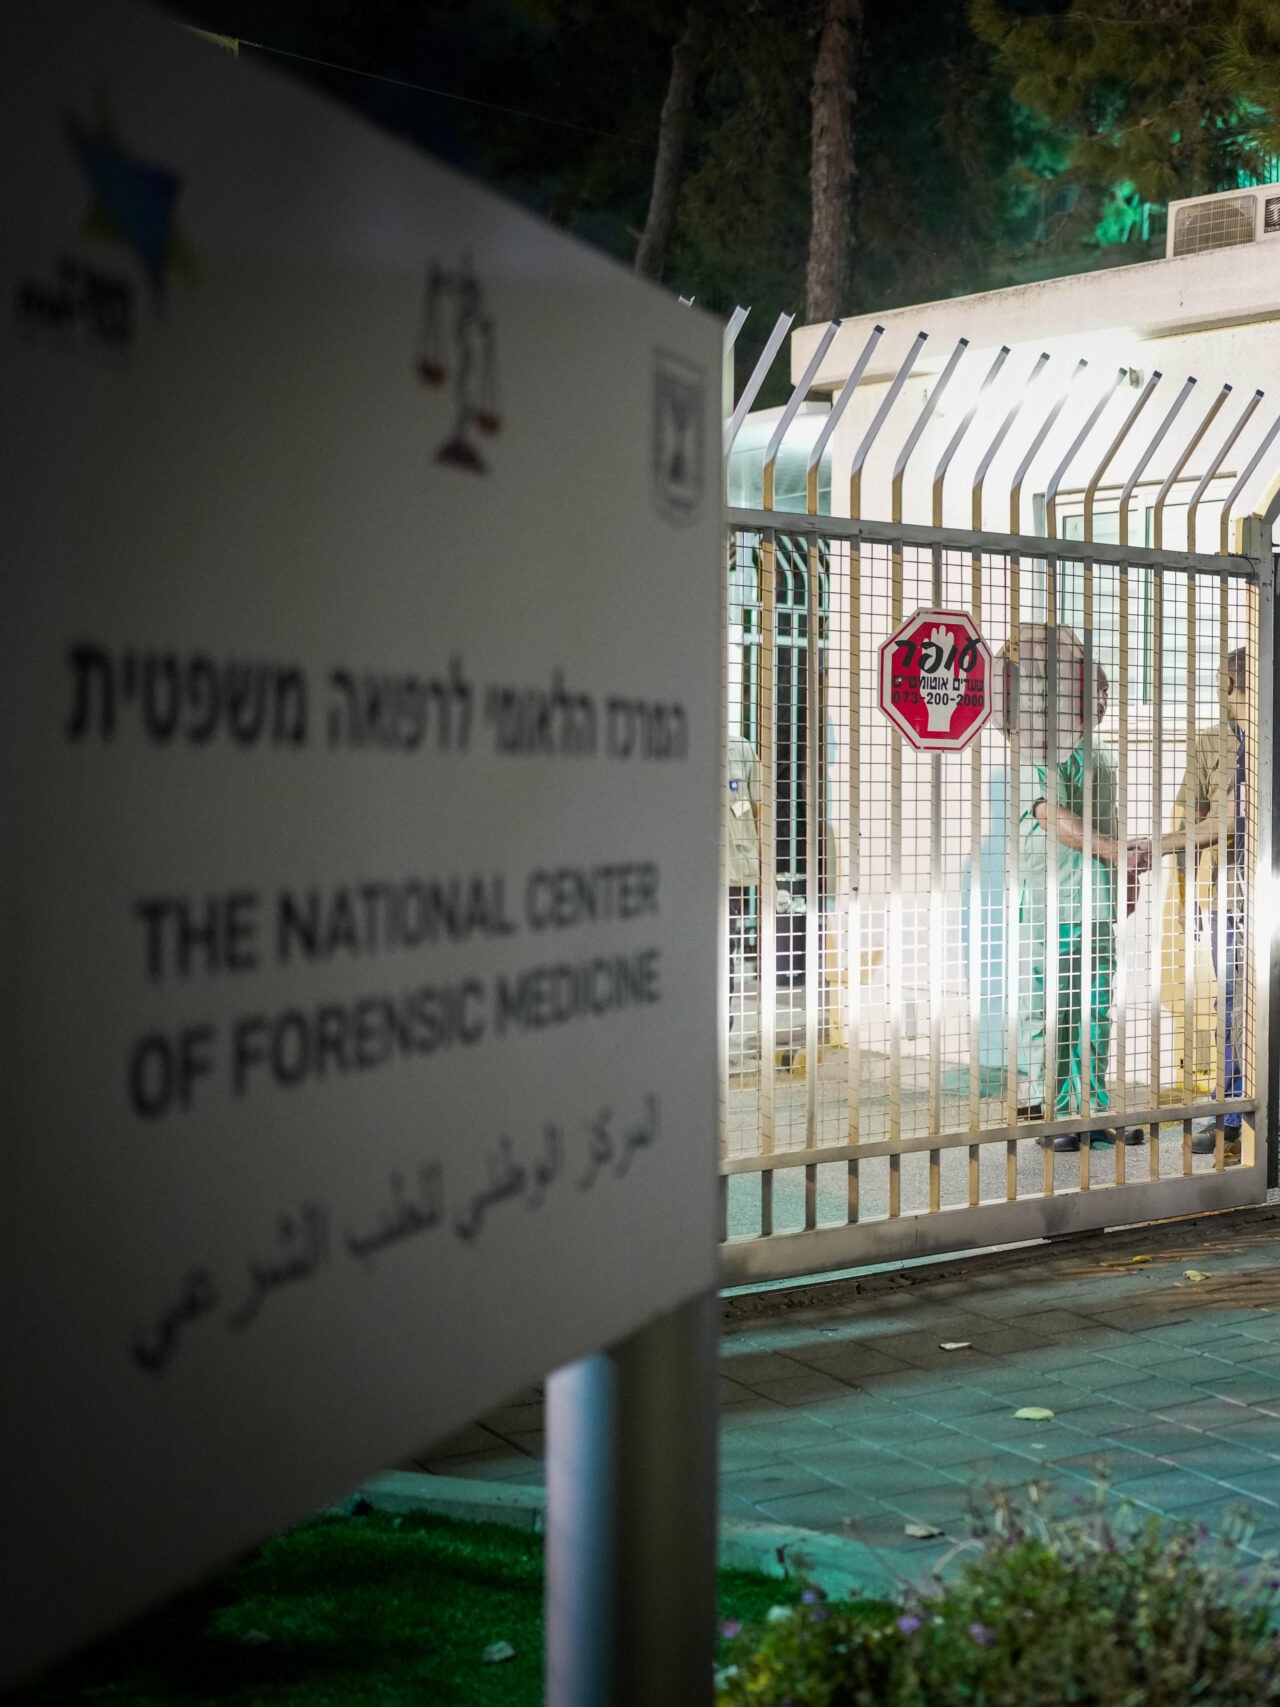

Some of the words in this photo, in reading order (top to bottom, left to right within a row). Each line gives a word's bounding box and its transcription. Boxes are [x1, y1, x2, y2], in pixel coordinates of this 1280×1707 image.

[63, 640, 308, 745] משפטית
[326, 651, 473, 754] לרפואה
[892, 692, 985, 707] 073-200-2000
[893, 675, 949, 691] אוטומטיים
[952, 679, 985, 692] שערים
[133, 886, 261, 983] THE
[277, 871, 517, 966] NATIONAL
[525, 861, 660, 931] CENTER
[127, 1022, 215, 1121] OF
[232, 977, 486, 1096] FORENSIC
[494, 947, 662, 1037] MEDICINE
